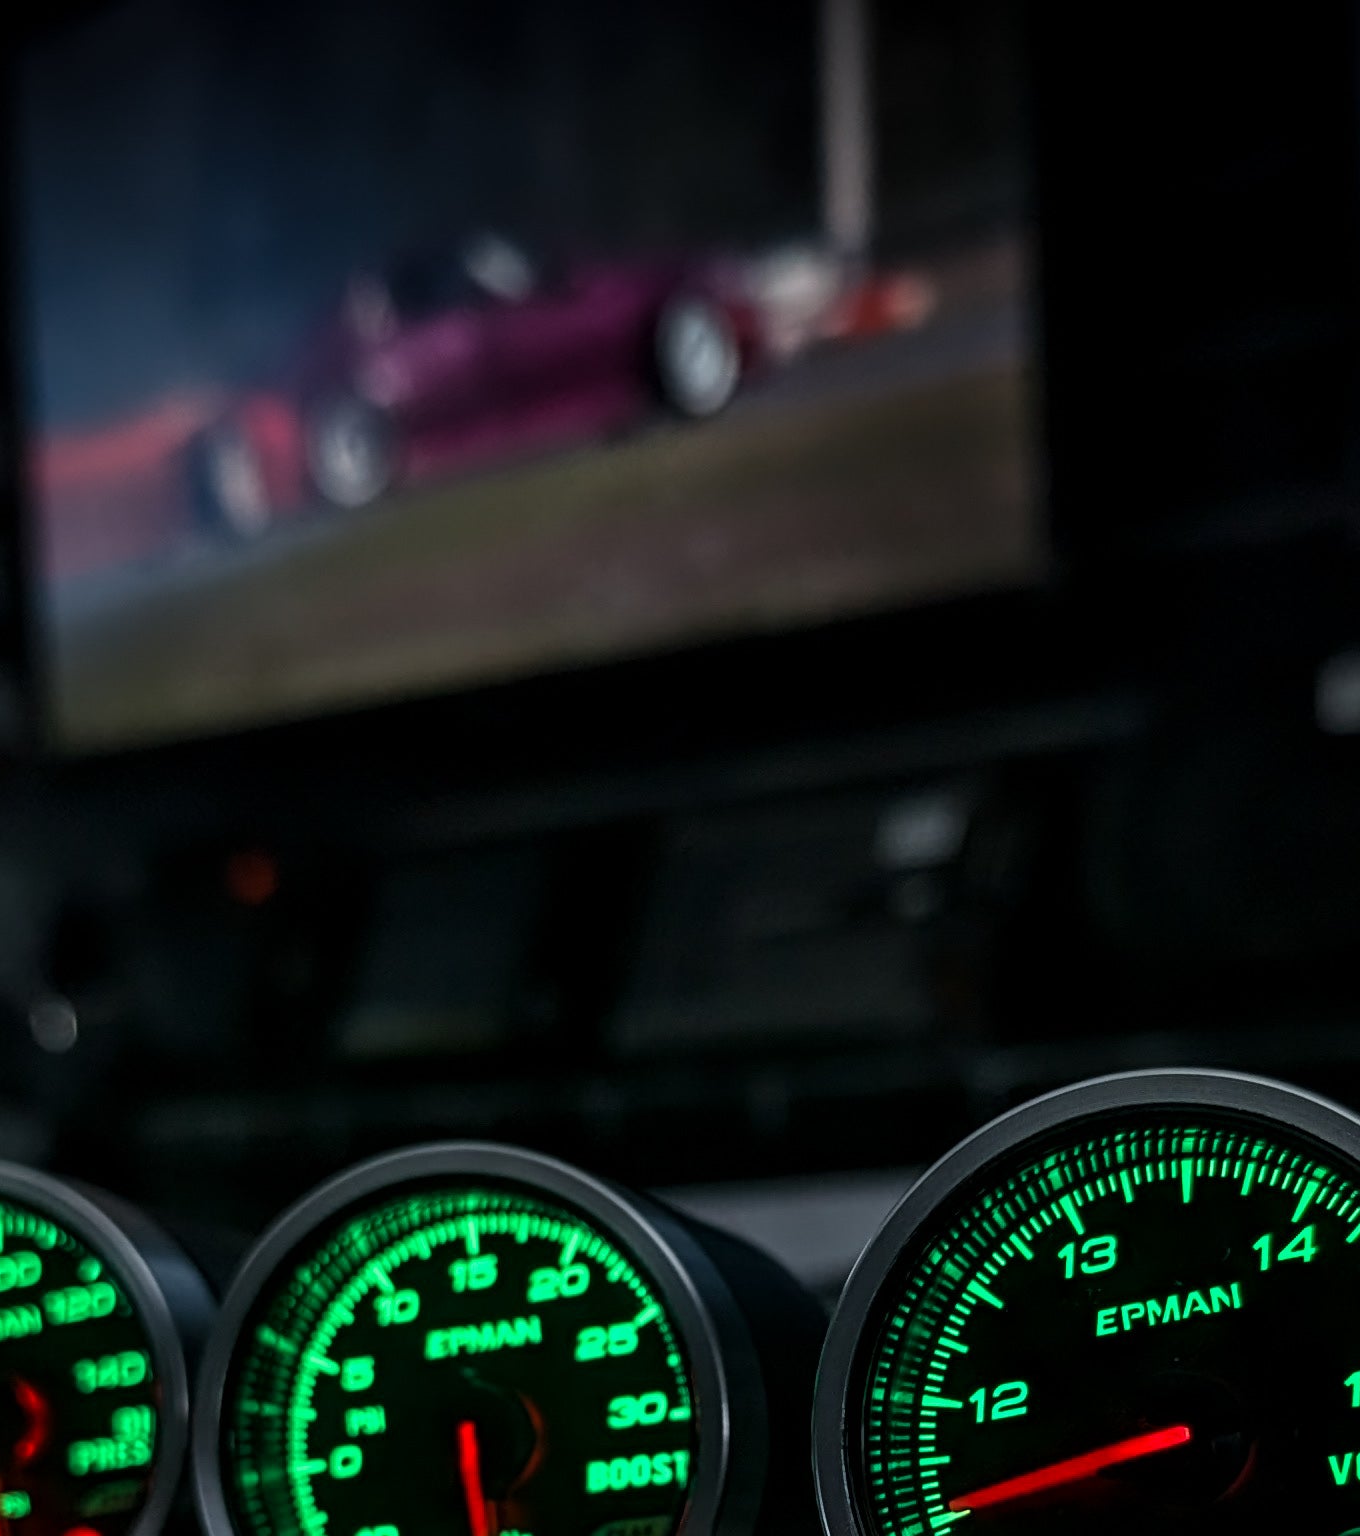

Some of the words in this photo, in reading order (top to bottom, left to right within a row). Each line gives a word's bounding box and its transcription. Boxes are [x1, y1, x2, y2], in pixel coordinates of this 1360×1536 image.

[1056, 1233, 1119, 1279] 13
[1252, 1224, 1319, 1272] 14
[448, 1254, 498, 1294] 15
[526, 1262, 590, 1303] 20
[373, 1288, 420, 1327] 10
[1095, 1282, 1241, 1338] EPMAN
[424, 1314, 542, 1361] EPMAN
[574, 1321, 640, 1362] 25
[340, 1355, 375, 1392] 5
[606, 1391, 669, 1429] 30
[969, 1379, 1030, 1423] 12
[329, 1444, 363, 1480] 0
[585, 1449, 691, 1494] BOOST
